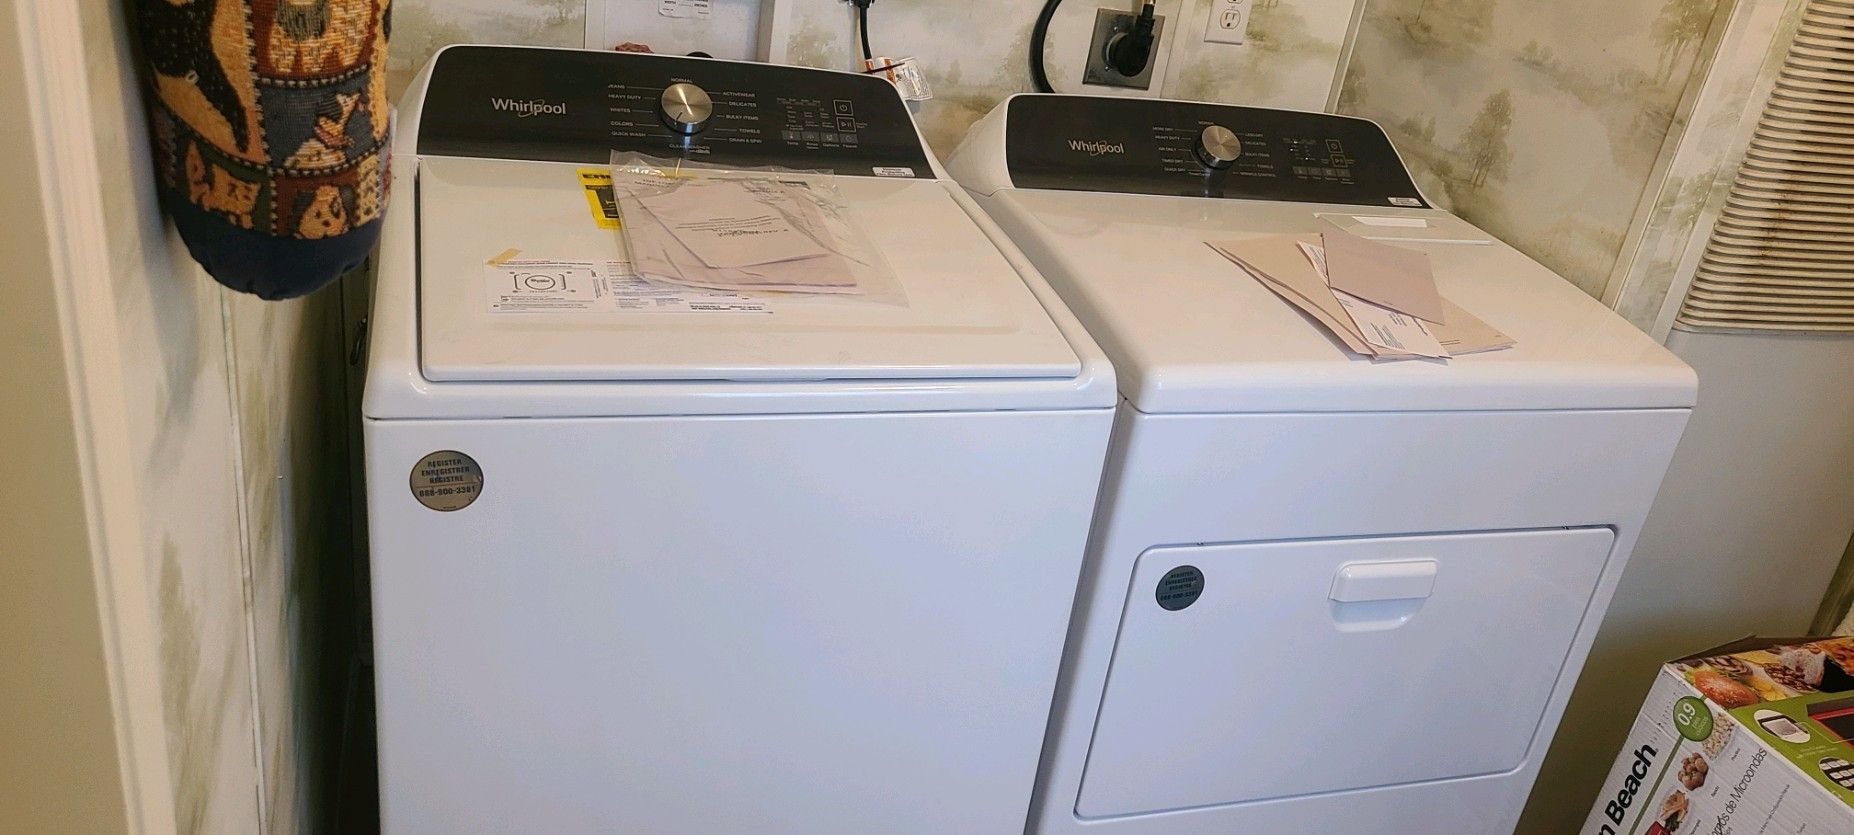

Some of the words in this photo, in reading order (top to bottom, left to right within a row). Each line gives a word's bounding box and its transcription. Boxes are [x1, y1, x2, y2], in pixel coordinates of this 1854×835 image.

[491, 97, 567, 117] Whirlpool
[1068, 139, 1124, 156] Whirlpool
[421, 466, 470, 477] ENREGISTRER
[427, 459, 462, 468] REGISTER
[1677, 703, 1696, 726] 0.9
[1730, 747, 1768, 803] Microondas
[1604, 744, 1657, 826] Beach
[1725, 800, 1737, 815] de
